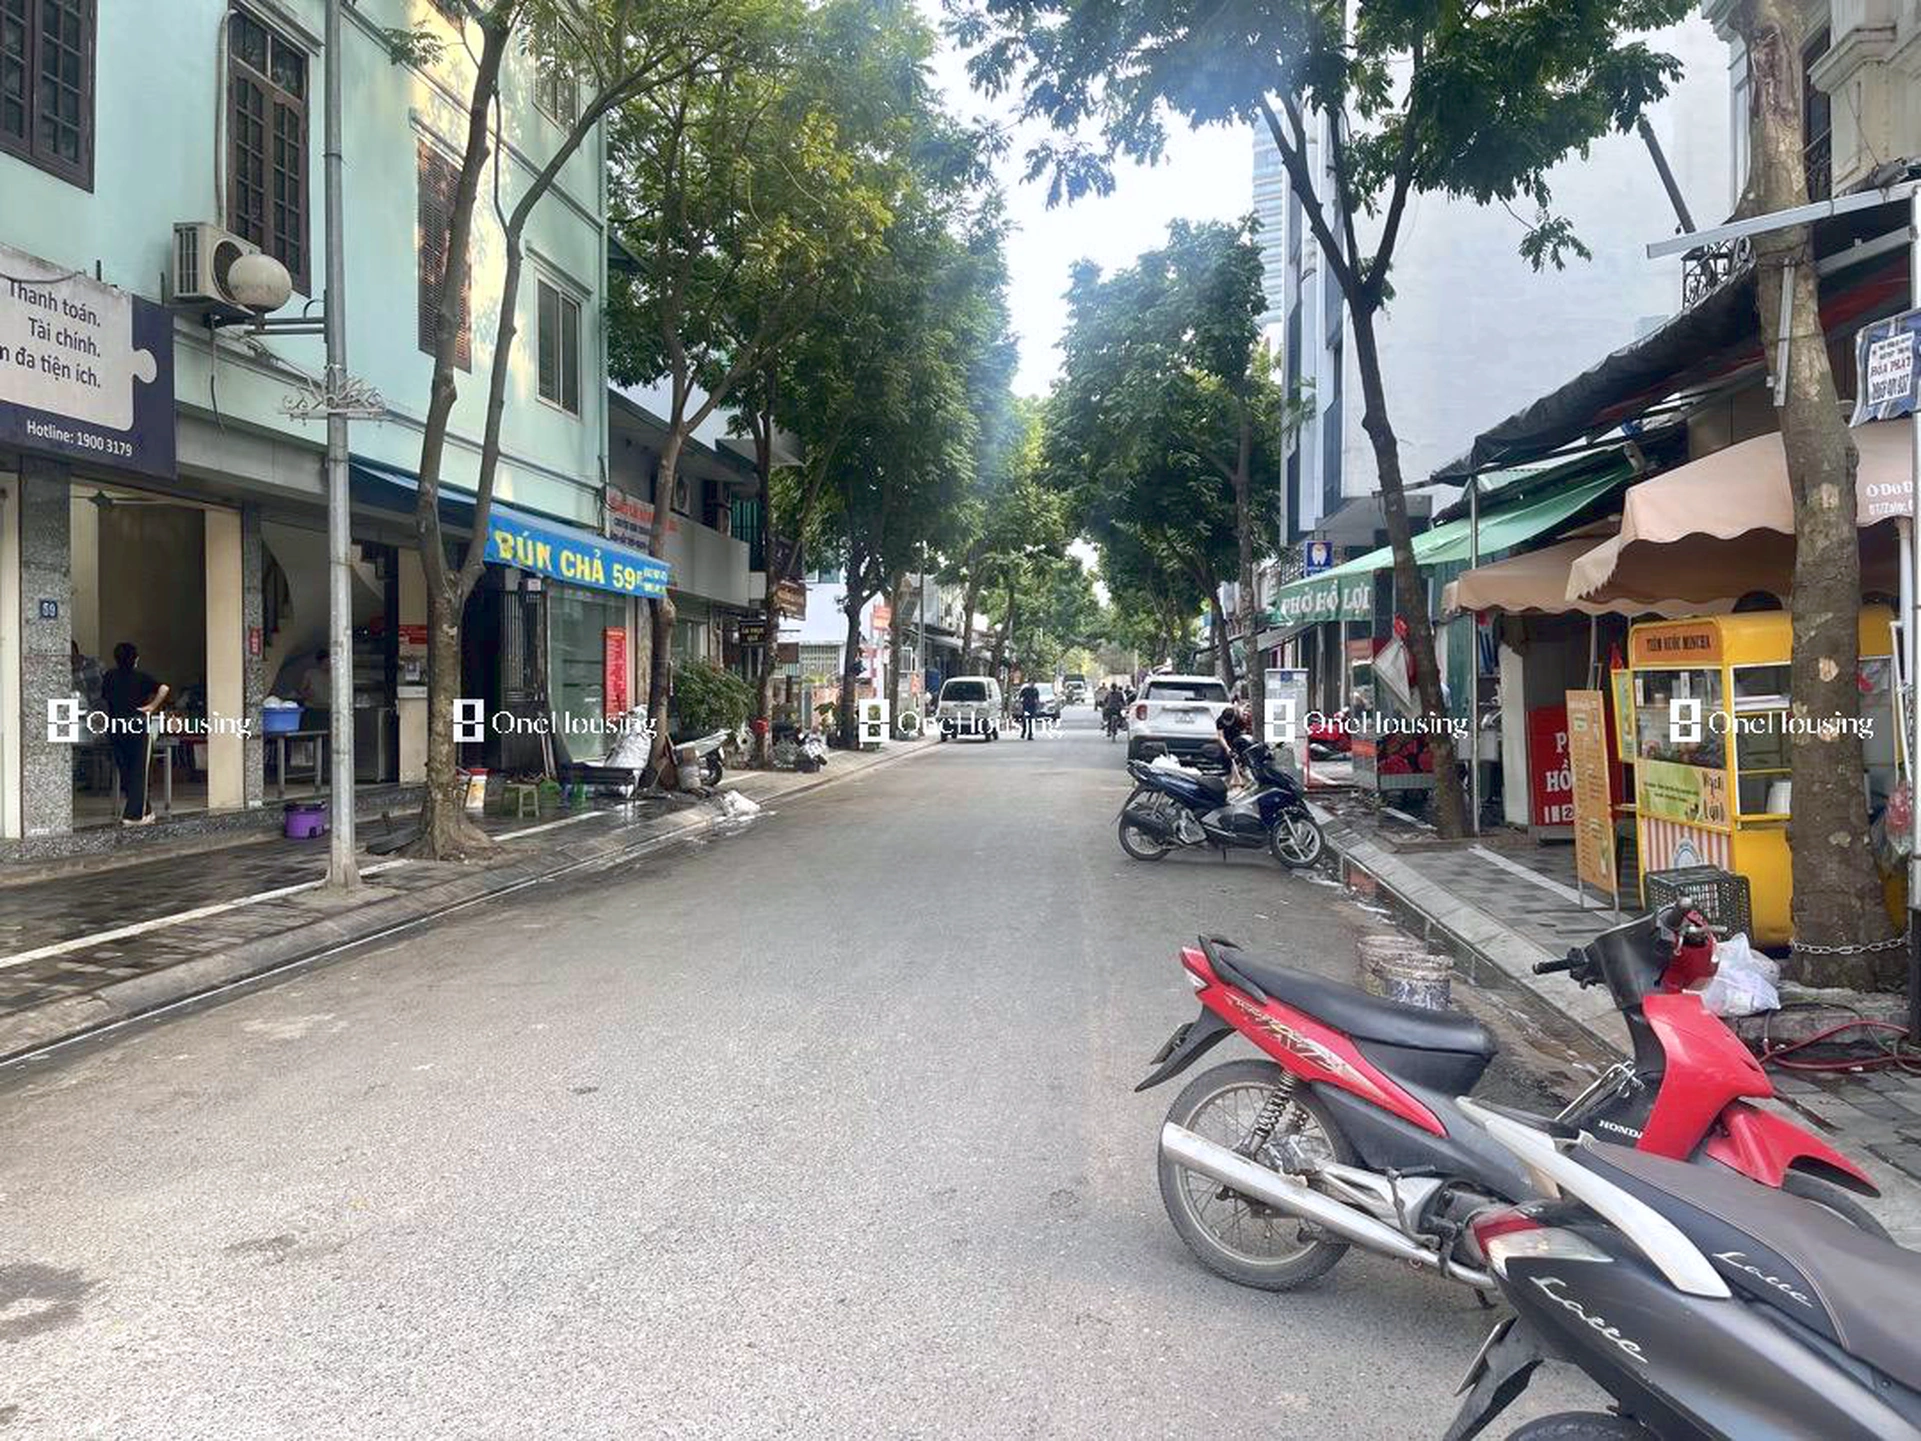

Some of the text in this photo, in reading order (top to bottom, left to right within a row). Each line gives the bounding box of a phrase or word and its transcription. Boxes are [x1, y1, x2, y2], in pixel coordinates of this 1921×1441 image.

[9, 280, 101, 327] Thanh toán.
[28, 317, 100, 358] Tài chính.
[15, 347, 35, 369] đa
[41, 355, 71, 380] tiện
[76, 363, 101, 388] ích.
[26, 419, 133, 457] Hotline: 1900 3179
[494, 529, 553, 571] BÚN
[559, 548, 606, 584] CHẢ
[612, 563, 637, 591] 59
[1281, 586, 1313, 614] PHỞ
